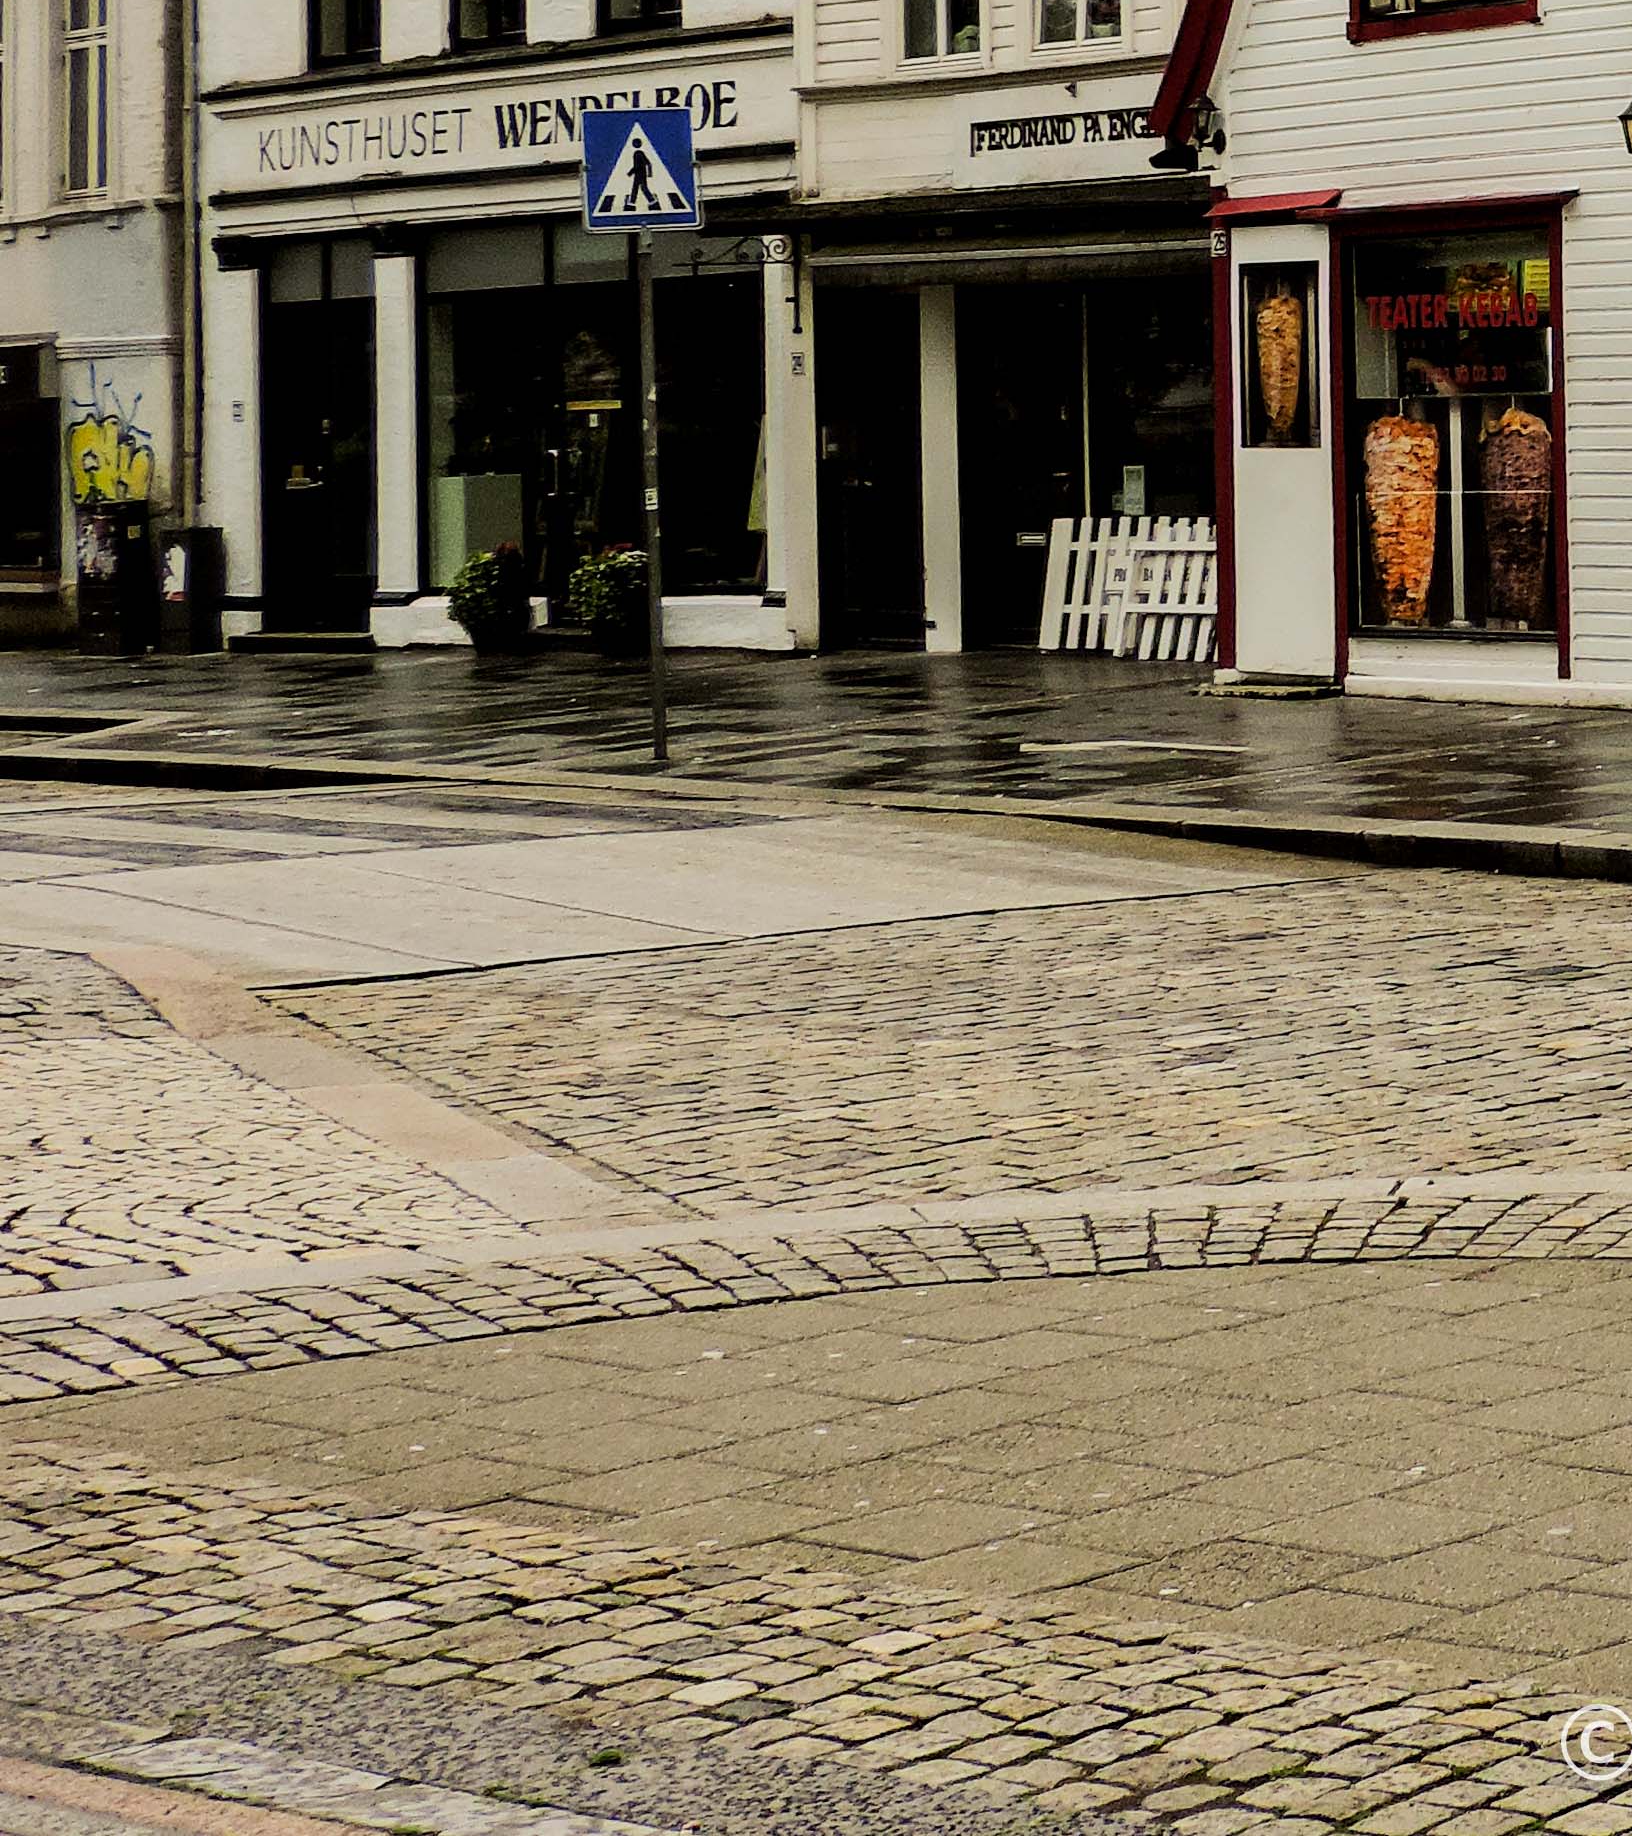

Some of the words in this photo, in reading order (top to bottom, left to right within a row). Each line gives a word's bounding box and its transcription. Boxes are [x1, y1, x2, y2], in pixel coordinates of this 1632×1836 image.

[257, 107, 473, 173] KUNSTHUSET
[494, 79, 740, 150] WENOE
[975, 116, 1076, 152] FERDINAND
[1365, 294, 1449, 331] TEATER
[1458, 291, 1538, 328] KEBAB
